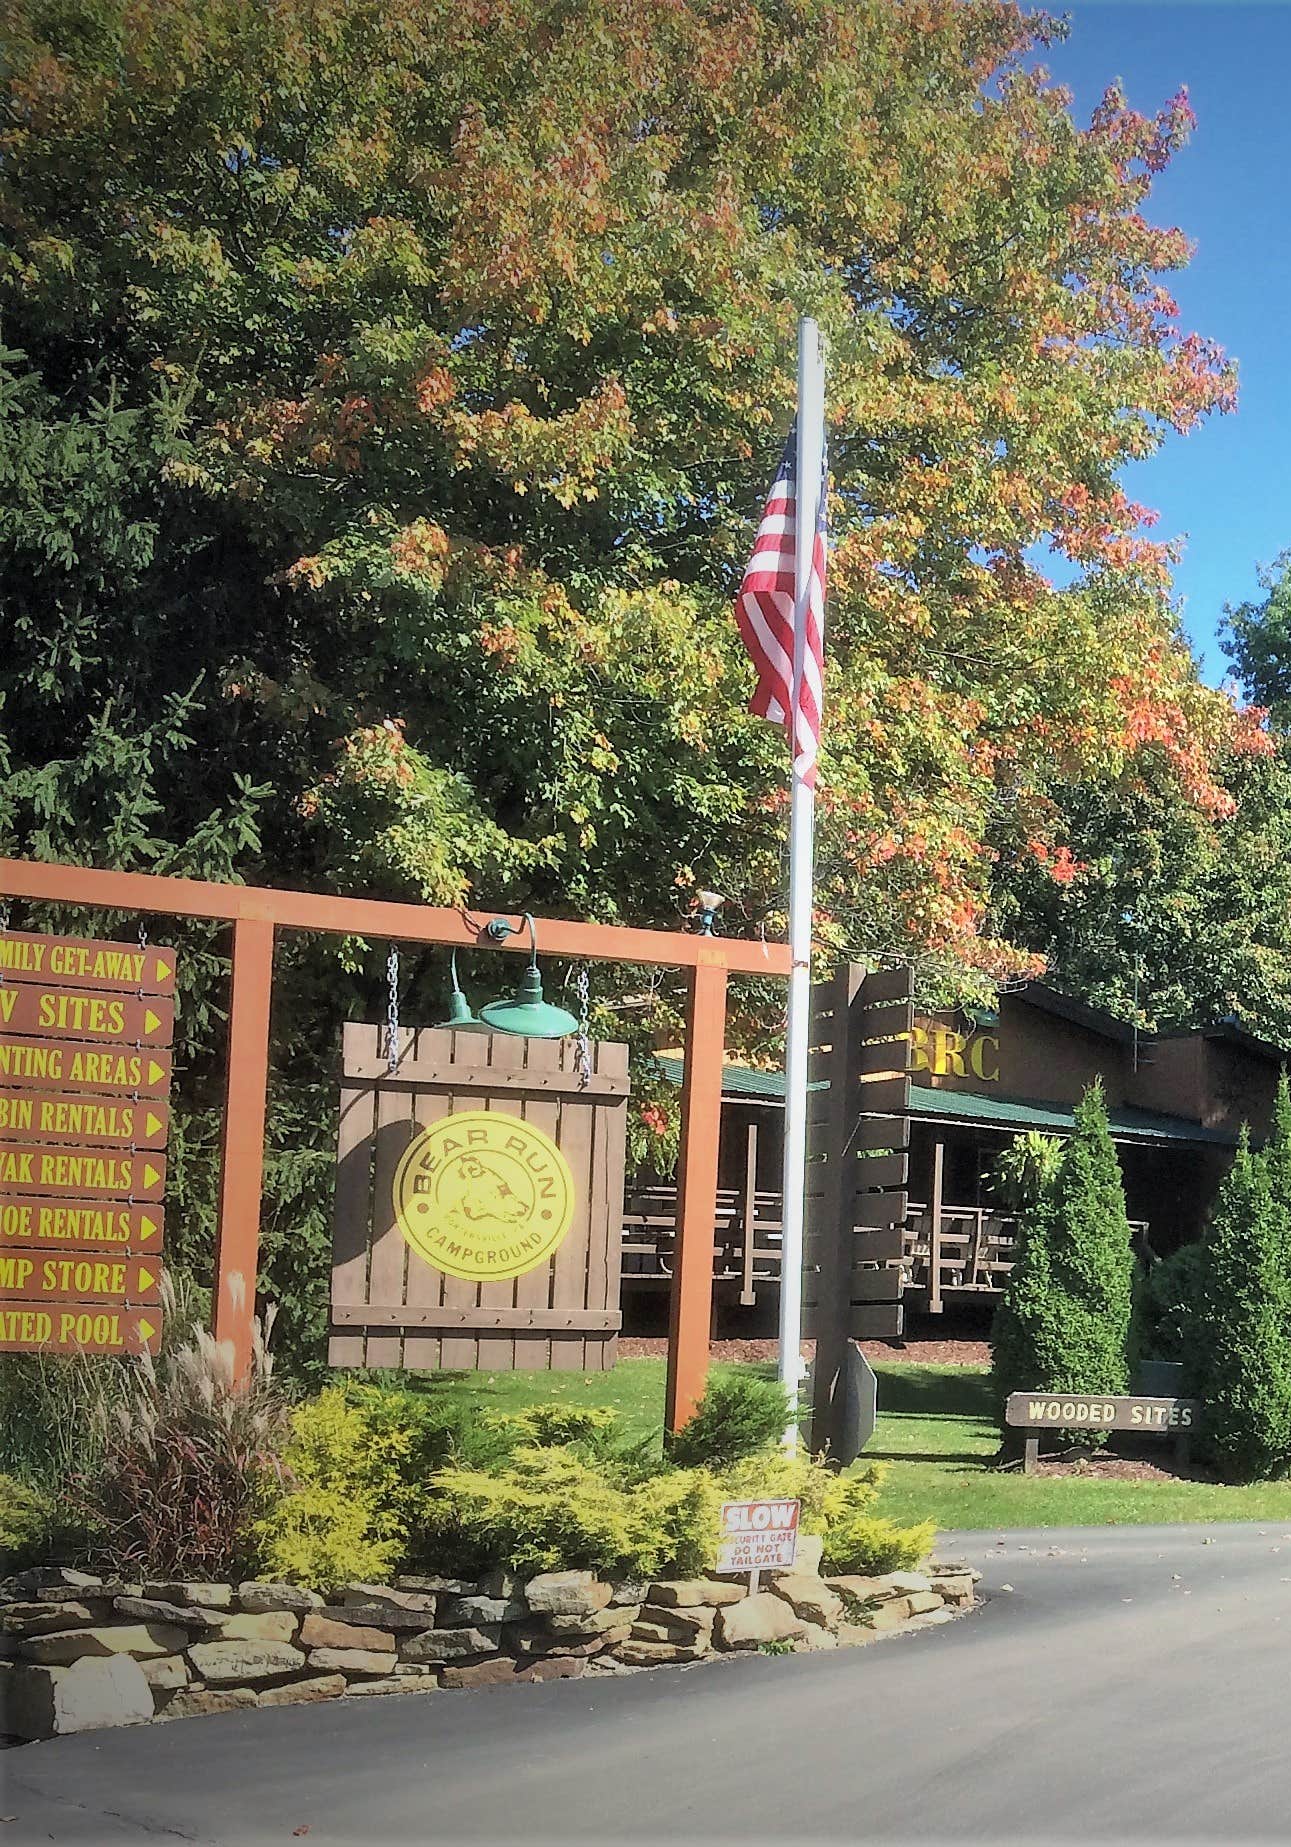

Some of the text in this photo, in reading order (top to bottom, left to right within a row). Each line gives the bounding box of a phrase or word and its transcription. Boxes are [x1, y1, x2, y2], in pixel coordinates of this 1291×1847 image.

[51, 945, 146, 982] GET-AWAY
[38, 993, 124, 1034] SITES
[0, 1045, 142, 1087] NTING AREAS
[910, 1027, 1000, 1081] BRC
[39, 1101, 134, 1138] RENTALS
[39, 1154, 132, 1191] RENTALS
[413, 1129, 557, 1199] BEAR RUN
[0, 1204, 131, 1242] OE RENTALS
[426, 1227, 543, 1265] CAMPGROUND
[42, 1260, 126, 1294] STORE
[59, 1313, 124, 1346] POOL
[1028, 1401, 1193, 1427] WOODED SITES
[726, 1504, 796, 1531] SLOW
[730, 1553, 783, 1566] TAILGATE
[734, 1543, 780, 1555] DO NOT
